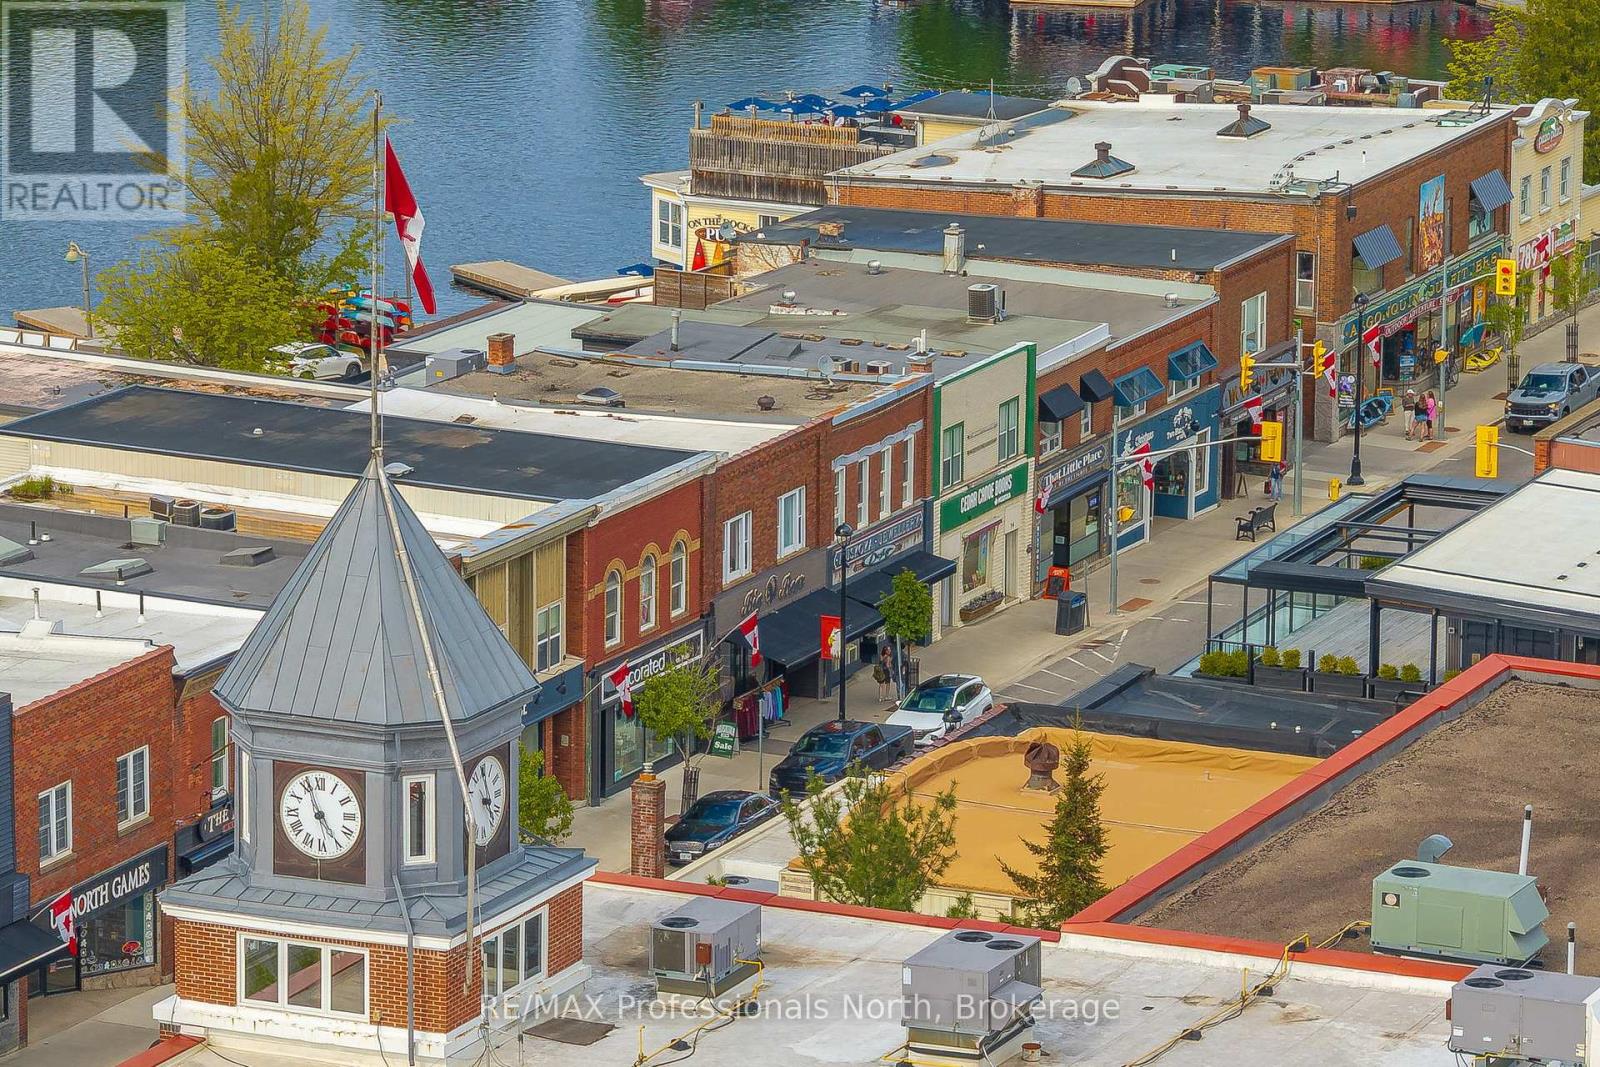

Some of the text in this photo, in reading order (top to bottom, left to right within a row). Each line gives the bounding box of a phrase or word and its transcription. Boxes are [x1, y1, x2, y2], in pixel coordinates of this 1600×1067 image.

[688, 219, 702, 229] ON
[702, 217, 721, 226] THE
[1349, 291, 1422, 337] AGONQUIN
[1044, 449, 1103, 487] That Little Place
[961, 491, 978, 514] CEDAR
[978, 482, 995, 505] CANOE
[994, 473, 1013, 497] BOOKS
[714, 740, 733, 751] Sale
[207, 808, 229, 833] THE
[69, 881, 109, 918] NORTH
[111, 862, 150, 899] GAMES
